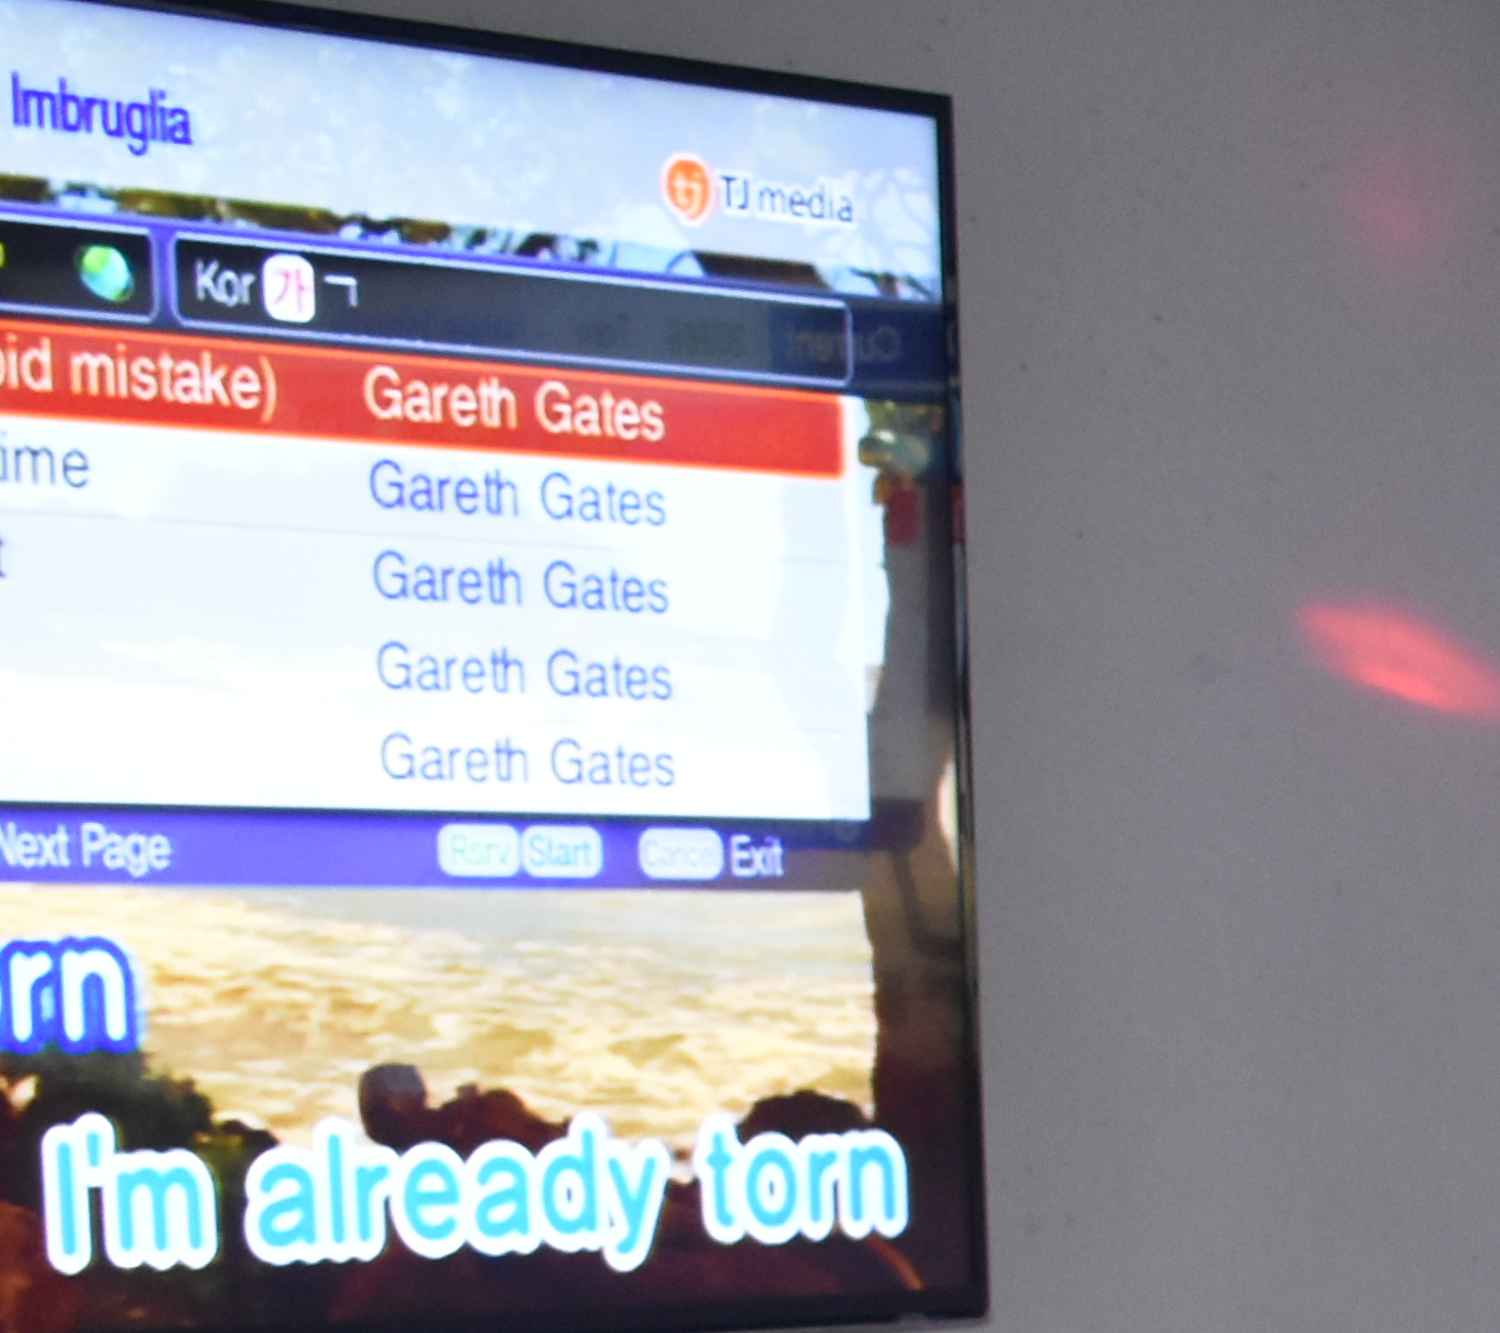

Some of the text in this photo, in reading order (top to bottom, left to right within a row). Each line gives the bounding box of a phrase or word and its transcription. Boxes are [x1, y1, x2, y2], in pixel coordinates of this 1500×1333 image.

[11, 71, 192, 156] Imbruglia
[720, 174, 750, 210] TJ
[758, 183, 854, 224] media
[196, 259, 251, 305] Kor
[72, 346, 277, 422] mistake)
[363, 365, 518, 432] Gareth
[535, 383, 664, 443] Gates
[369, 459, 519, 518] Gareth
[541, 472, 667, 527] Gates
[373, 550, 670, 615] Gareth Gates
[377, 642, 674, 702] Gareth Gates
[381, 731, 676, 788] Gareth Gates
[82, 822, 172, 878] Page
[529, 834, 594, 868] Start
[732, 835, 784, 877] Exit
[41, 1112, 909, 1273] I'm already torn
